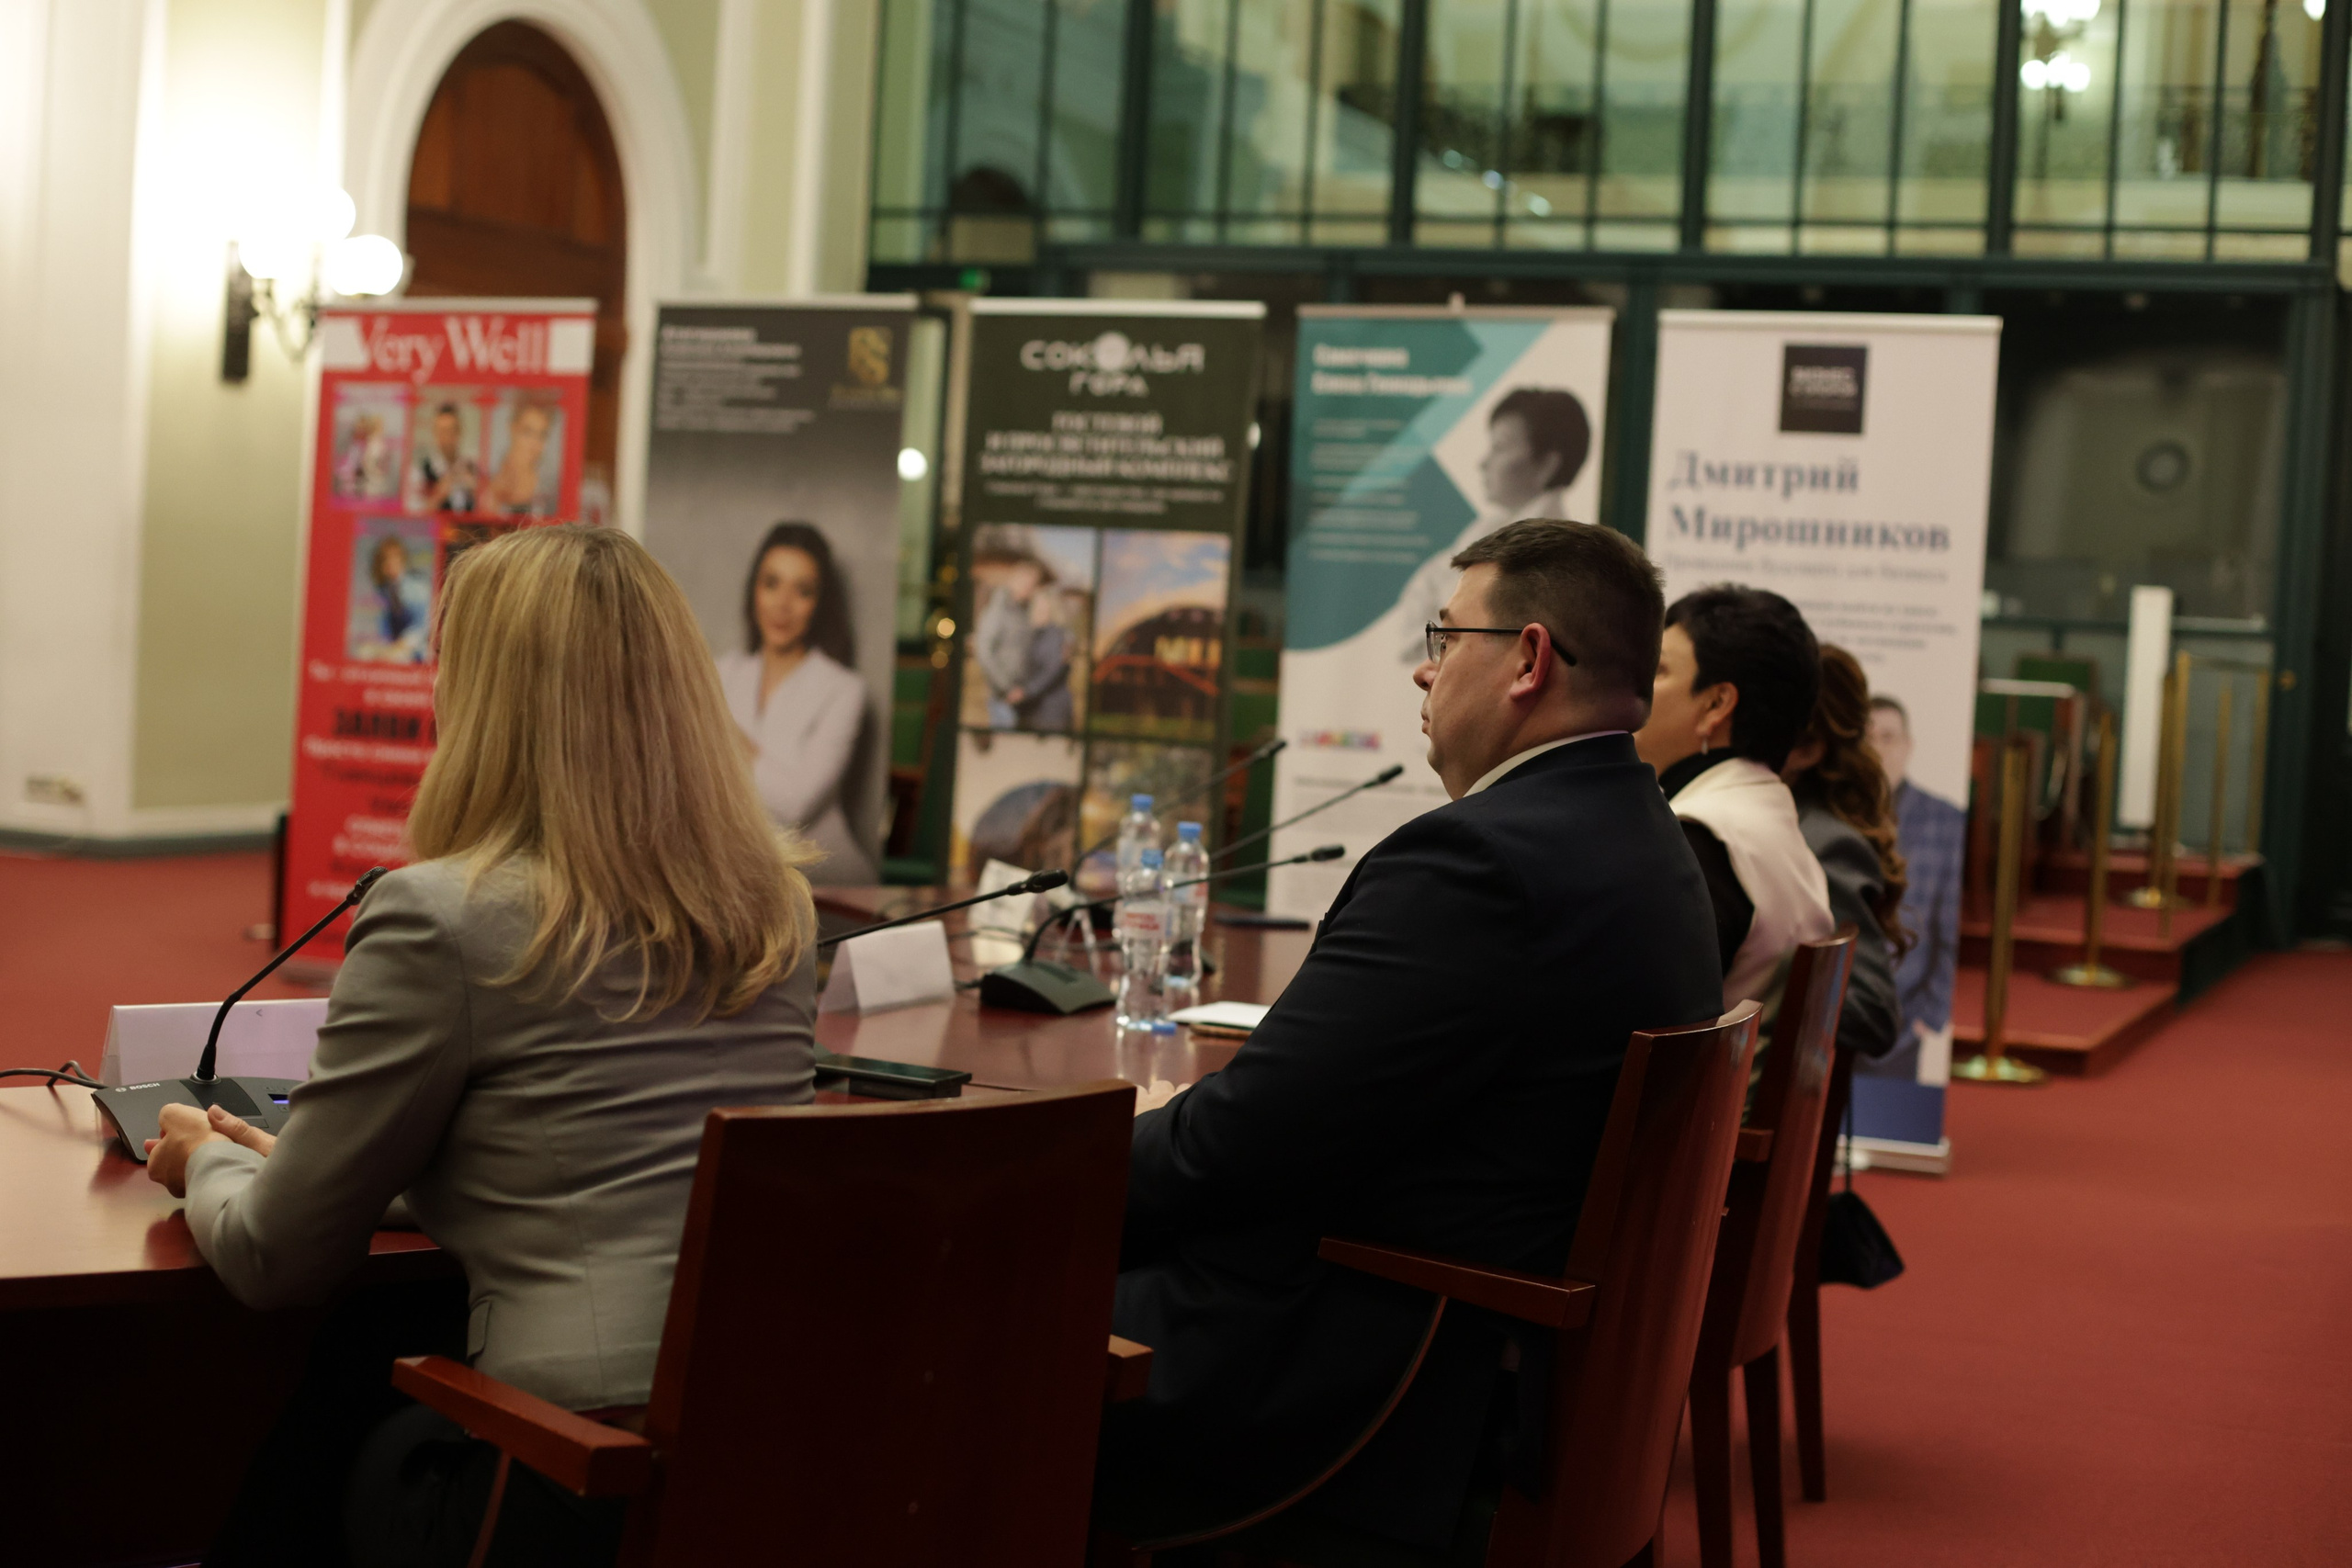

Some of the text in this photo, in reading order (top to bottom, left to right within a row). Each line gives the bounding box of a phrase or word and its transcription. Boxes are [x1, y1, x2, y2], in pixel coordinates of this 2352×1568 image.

[358, 316, 549, 386] Very Well
[1069, 371, 1148, 397] ГОРА
[1667, 449, 1860, 499] Дмитрий
[1668, 502, 1951, 553] Мирошников
[129, 1082, 161, 1090] BOSCH
